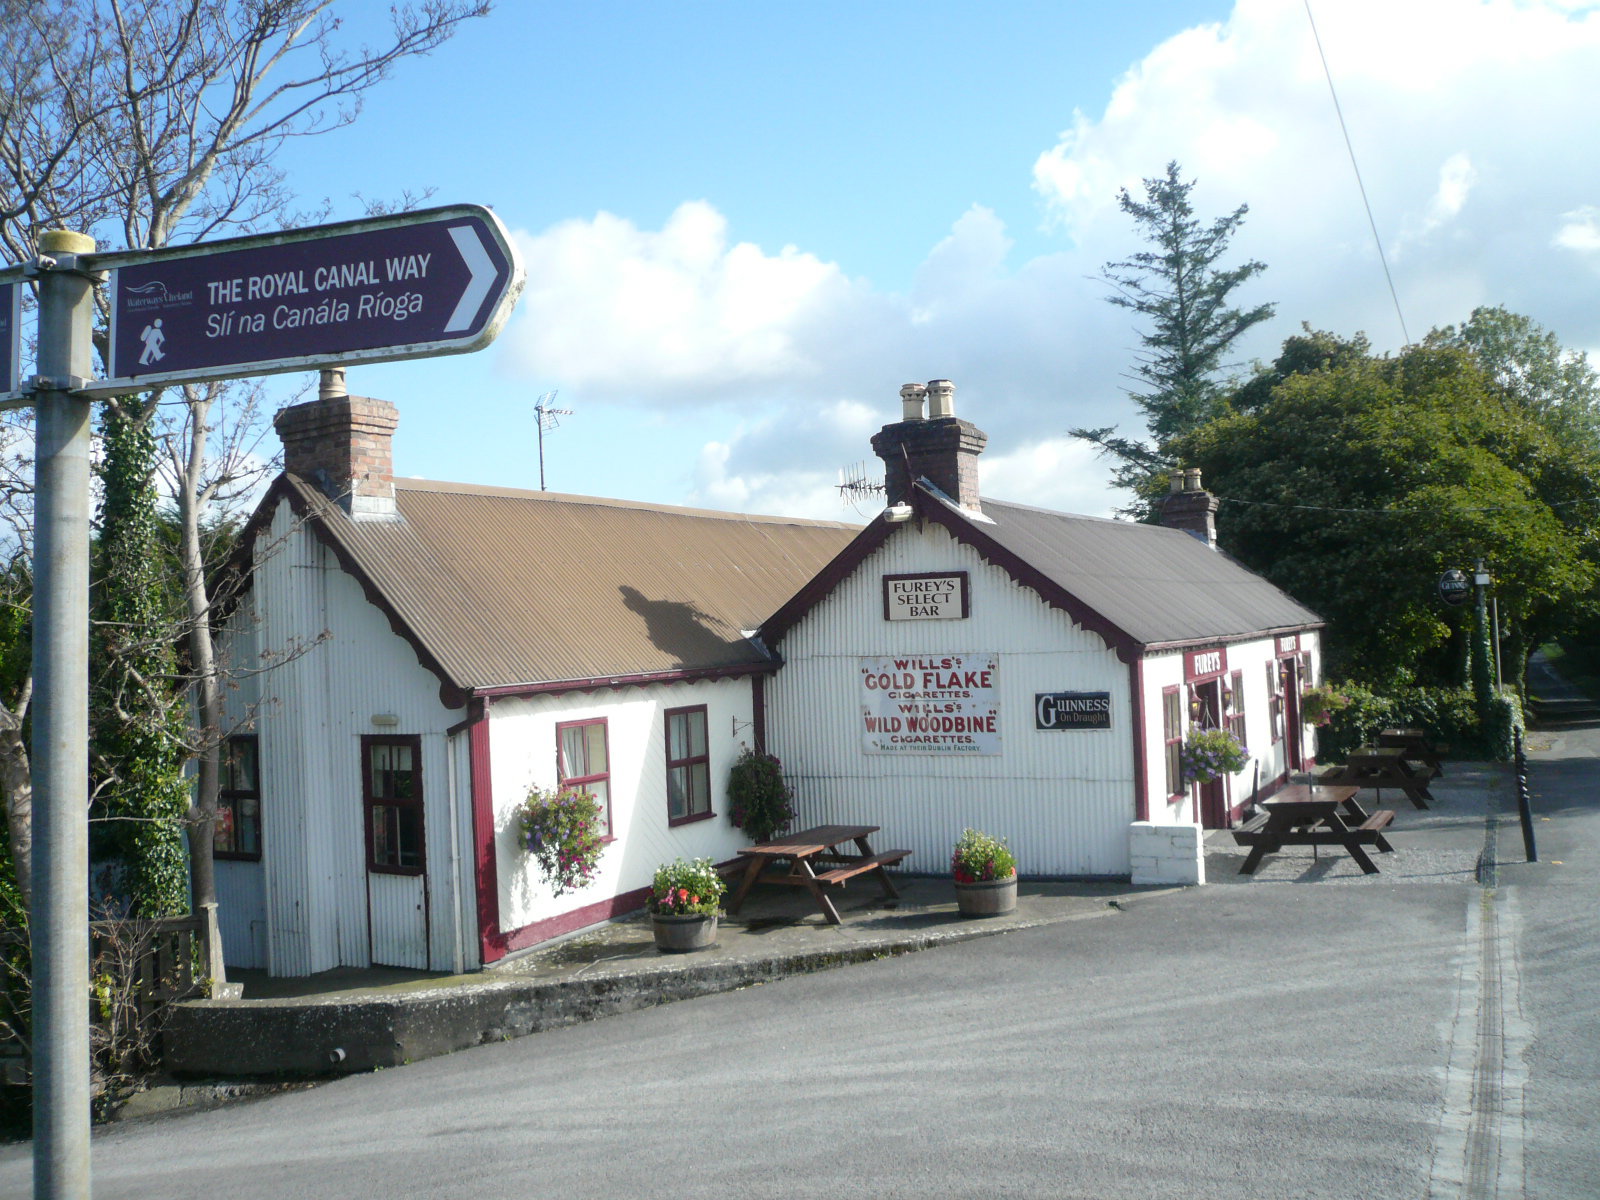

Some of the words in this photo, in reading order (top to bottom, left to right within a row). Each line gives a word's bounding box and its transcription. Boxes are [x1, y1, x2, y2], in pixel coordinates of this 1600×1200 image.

[207, 278, 242, 305] THE
[248, 270, 309, 300] ROYAL
[314, 260, 380, 291] CANAL
[385, 253, 431, 282] WAY
[206, 310, 236, 338] Slí
[238, 313, 265, 334] na
[272, 298, 350, 330] Canála
[357, 291, 423, 321] Ríoga
[893, 580, 955, 593] FUREY'S
[897, 592, 952, 606] SELECT
[910, 605, 939, 617] BAR
[1038, 695, 1109, 727] GUINNESS
[1060, 712, 1072, 722] On
[1073, 712, 1107, 725] Draught
